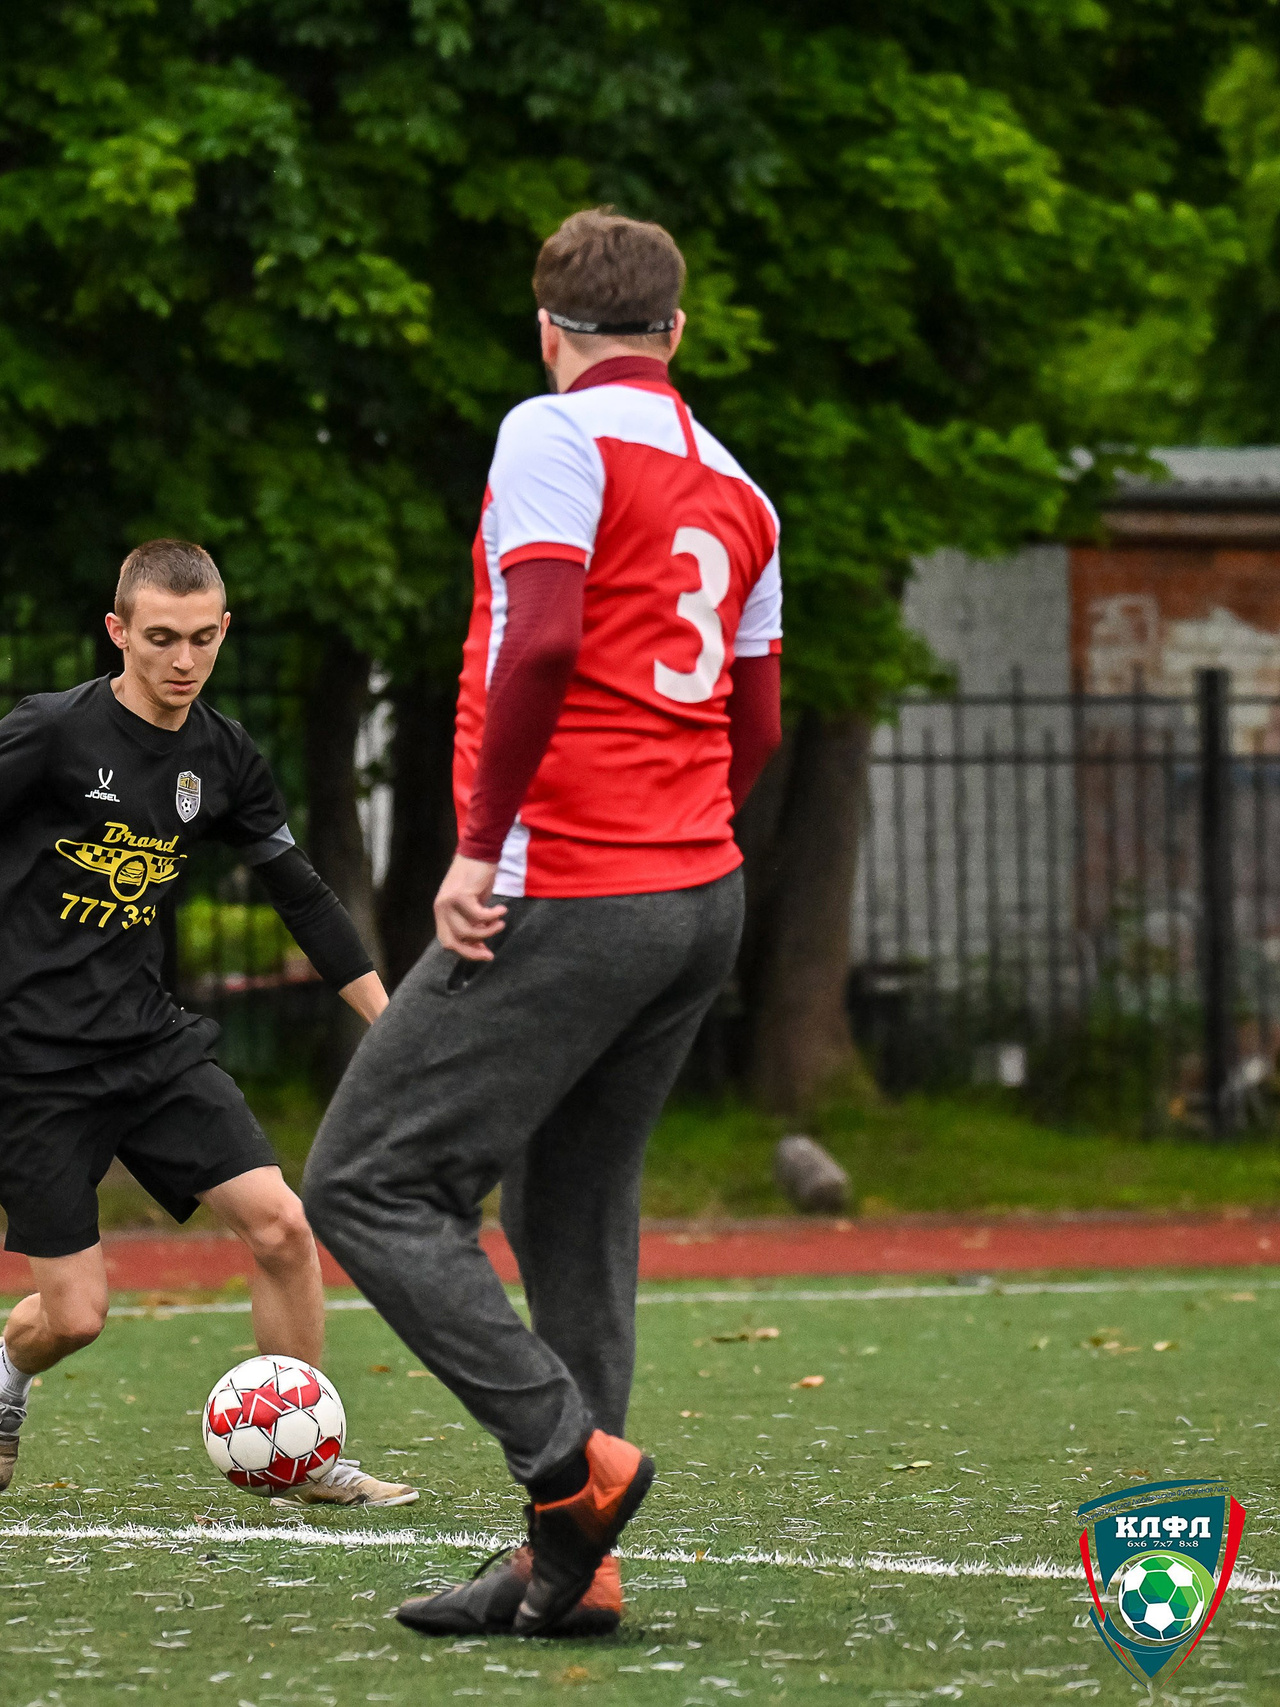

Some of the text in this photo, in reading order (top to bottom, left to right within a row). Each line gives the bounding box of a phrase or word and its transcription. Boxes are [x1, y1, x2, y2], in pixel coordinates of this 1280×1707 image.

[654, 526, 730, 704] 3
[84, 789, 121, 803] JÖGEL
[102, 821, 179, 853] Brand
[60, 892, 118, 929] 777
